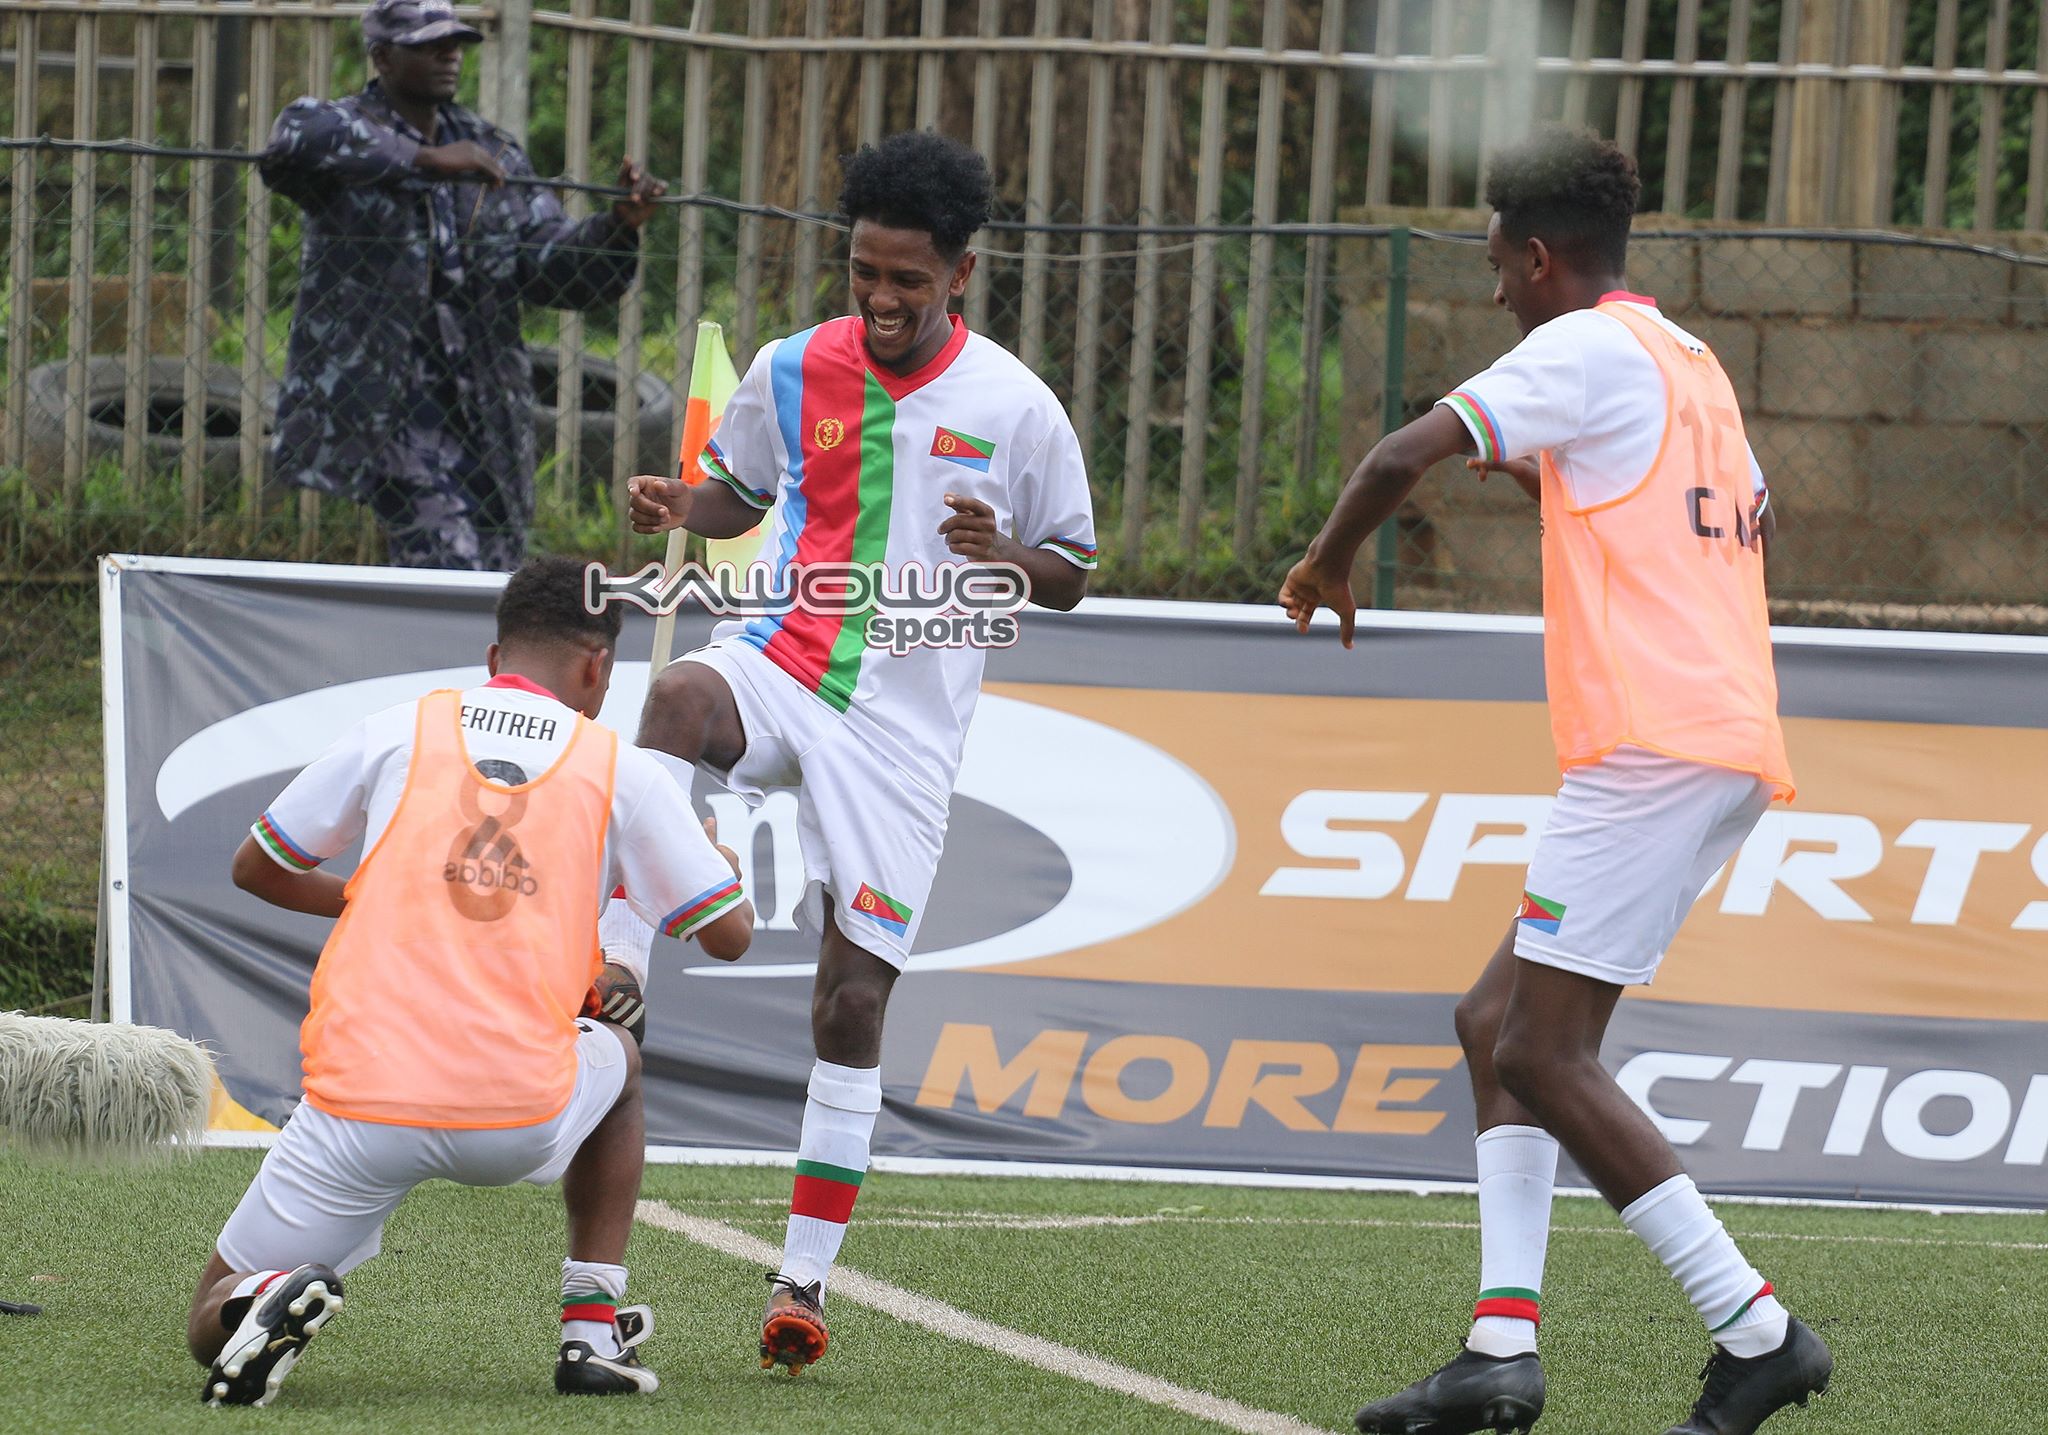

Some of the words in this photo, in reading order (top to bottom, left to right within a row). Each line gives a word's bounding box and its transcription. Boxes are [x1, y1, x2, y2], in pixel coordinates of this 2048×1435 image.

[461, 704, 557, 742] ERITREA
[446, 758, 529, 922] 8
[1259, 789, 2048, 931] SPRT
[914, 1022, 1465, 1135] MORE
[1616, 1051, 2048, 1166] CTIO
